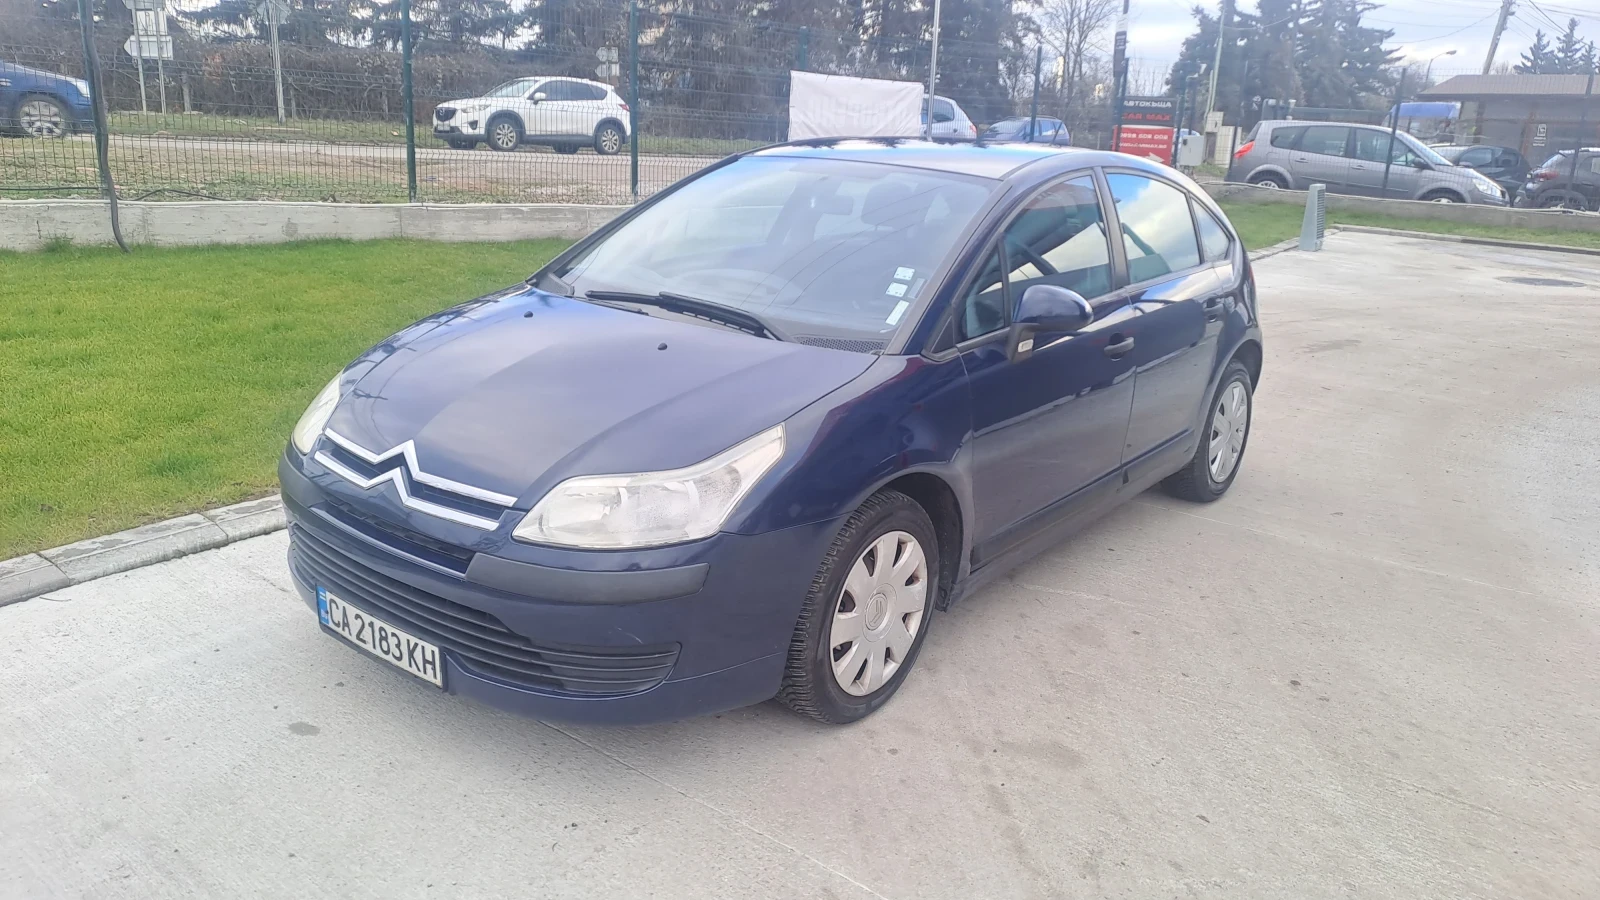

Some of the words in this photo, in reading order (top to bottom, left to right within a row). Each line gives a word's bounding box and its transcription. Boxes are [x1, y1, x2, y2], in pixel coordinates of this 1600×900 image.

[1123, 100, 1172, 108] АВТОКЪЩА
[328, 598, 352, 637] CA
[354, 613, 403, 662] 2183
[406, 638, 438, 680] KH
